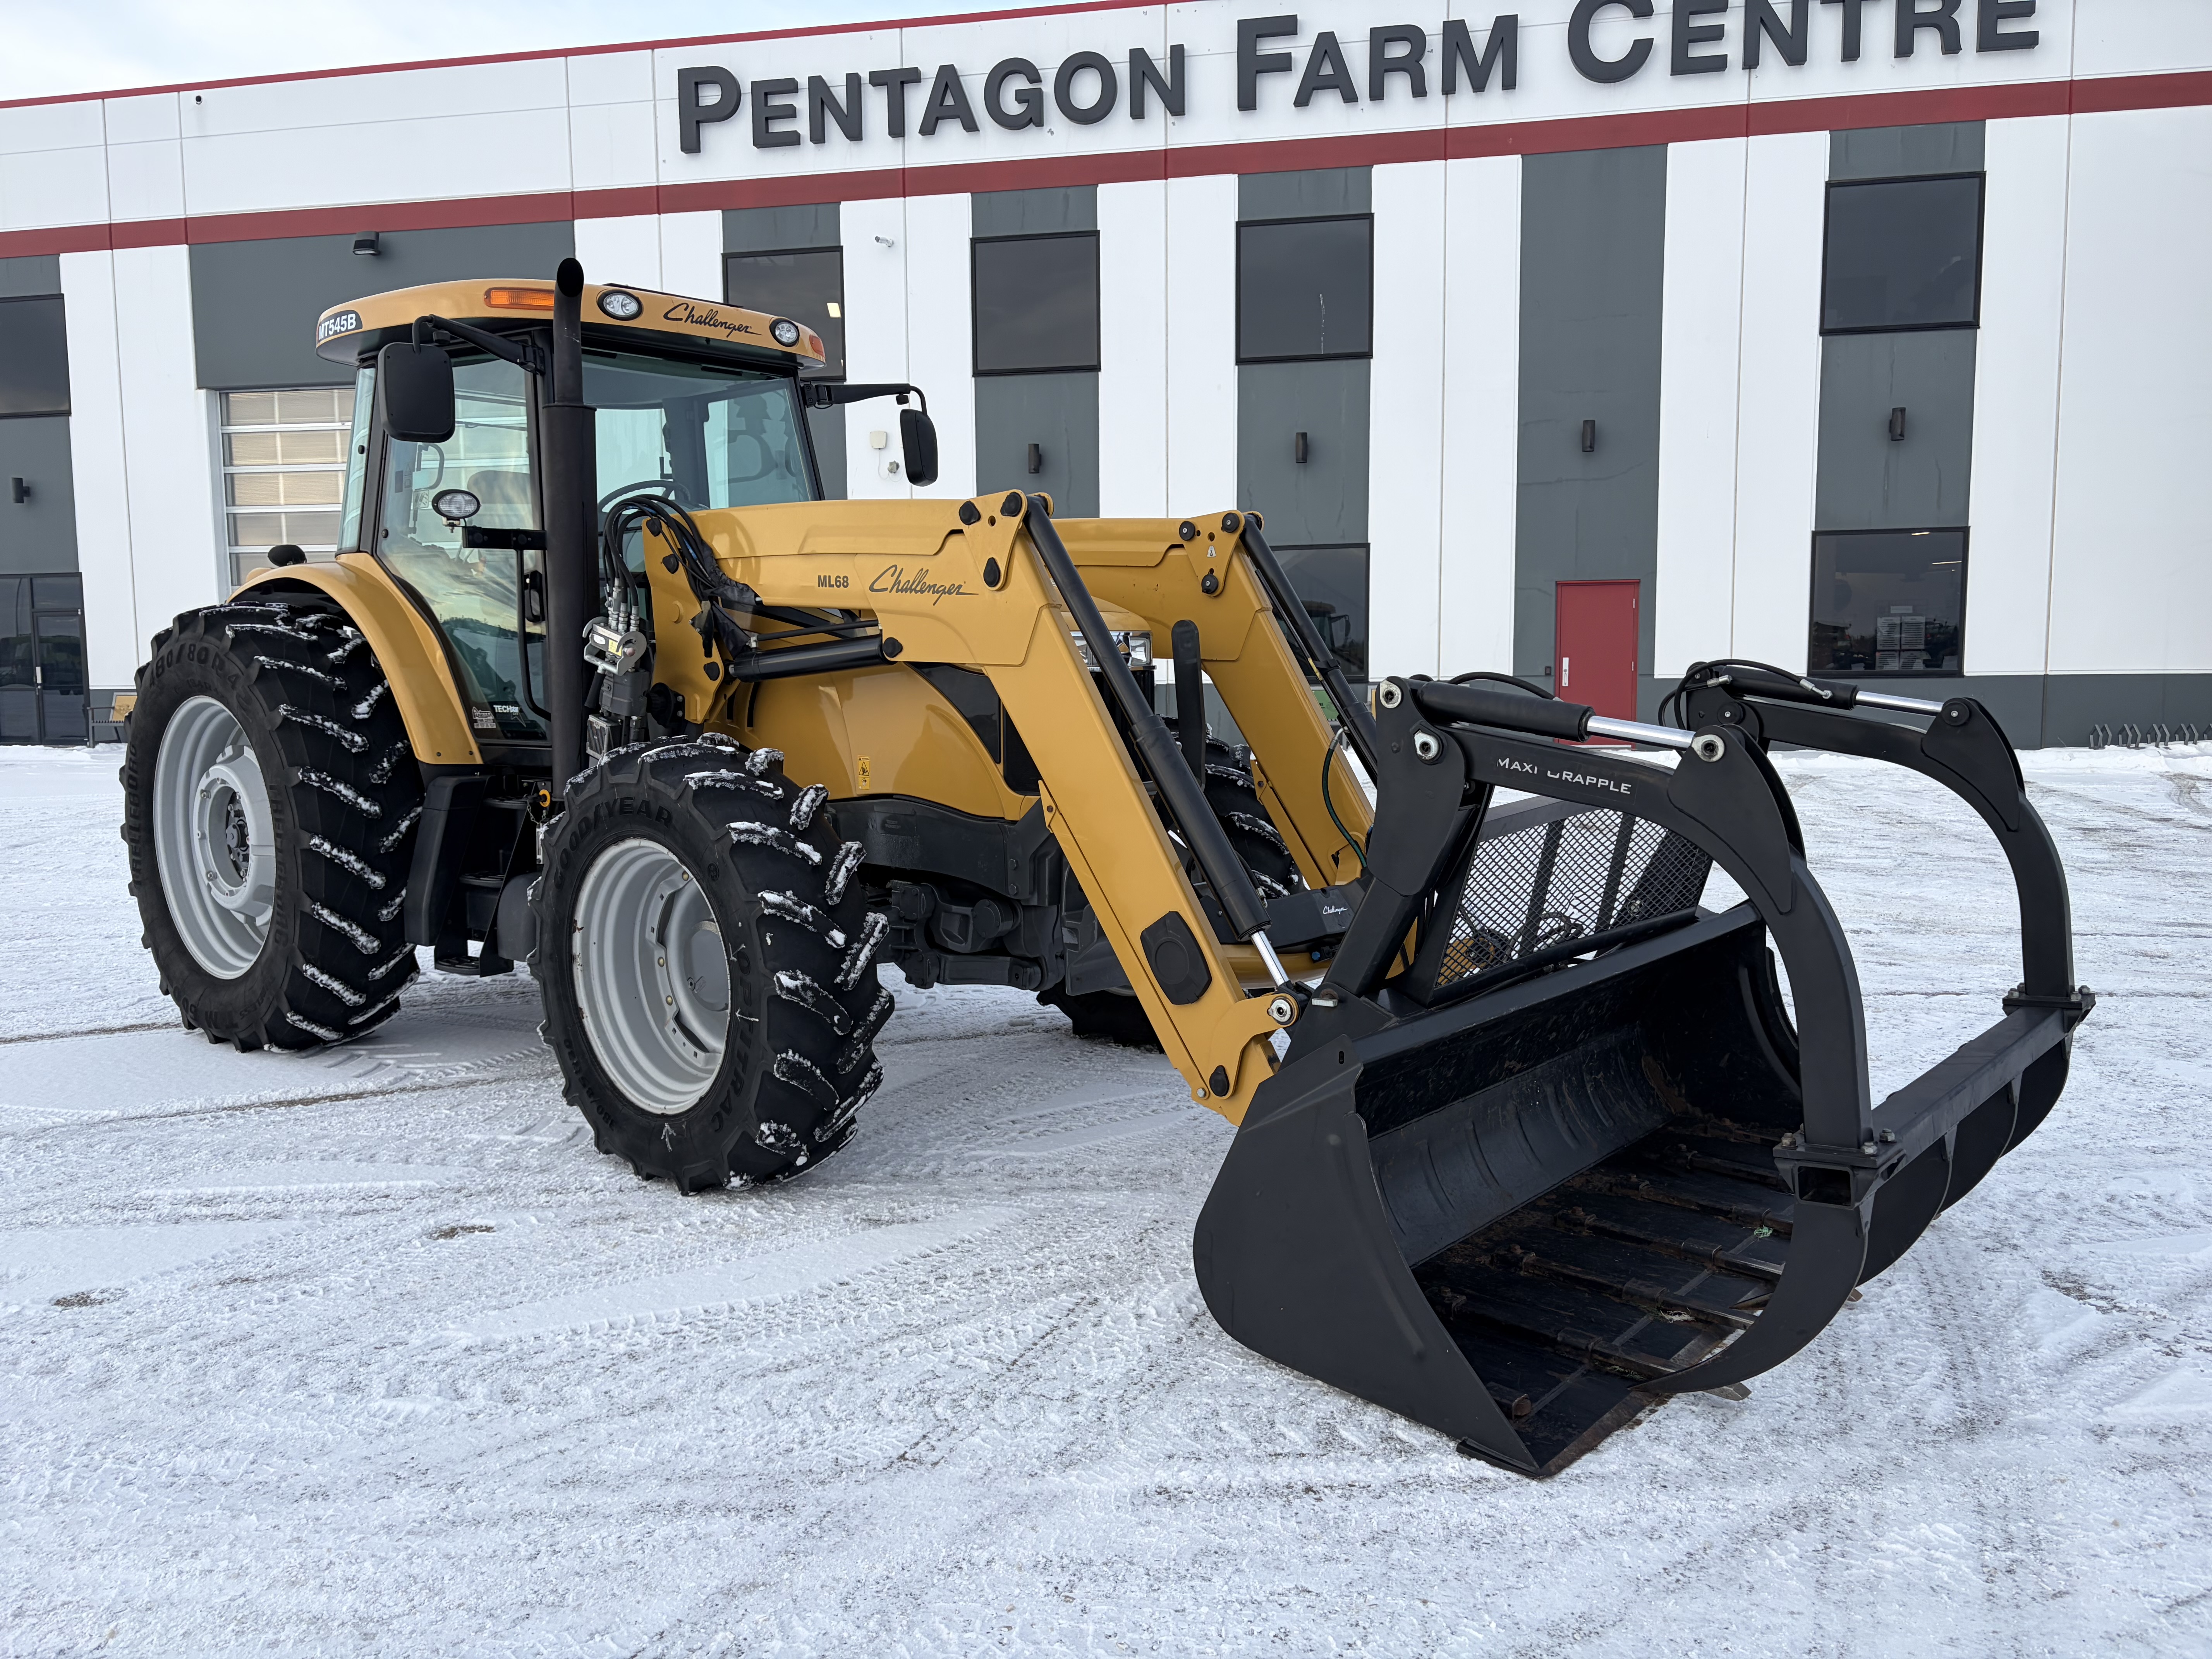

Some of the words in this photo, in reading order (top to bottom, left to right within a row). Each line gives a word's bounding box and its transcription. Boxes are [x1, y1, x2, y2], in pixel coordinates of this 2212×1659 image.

[677, 44, 1186, 154] PENTAGON
[1237, 14, 1518, 111] FARM
[1567, 0, 2039, 84] CENTRE
[318, 313, 356, 341] MT545B
[663, 302, 763, 338] Challenger
[817, 575, 849, 588] ML68
[869, 564, 979, 606] Challenger
[1497, 758, 1538, 774] MAXI
[554, 796, 673, 890] GOODYEAR
[711, 950, 753, 1133] OPTITRAC
